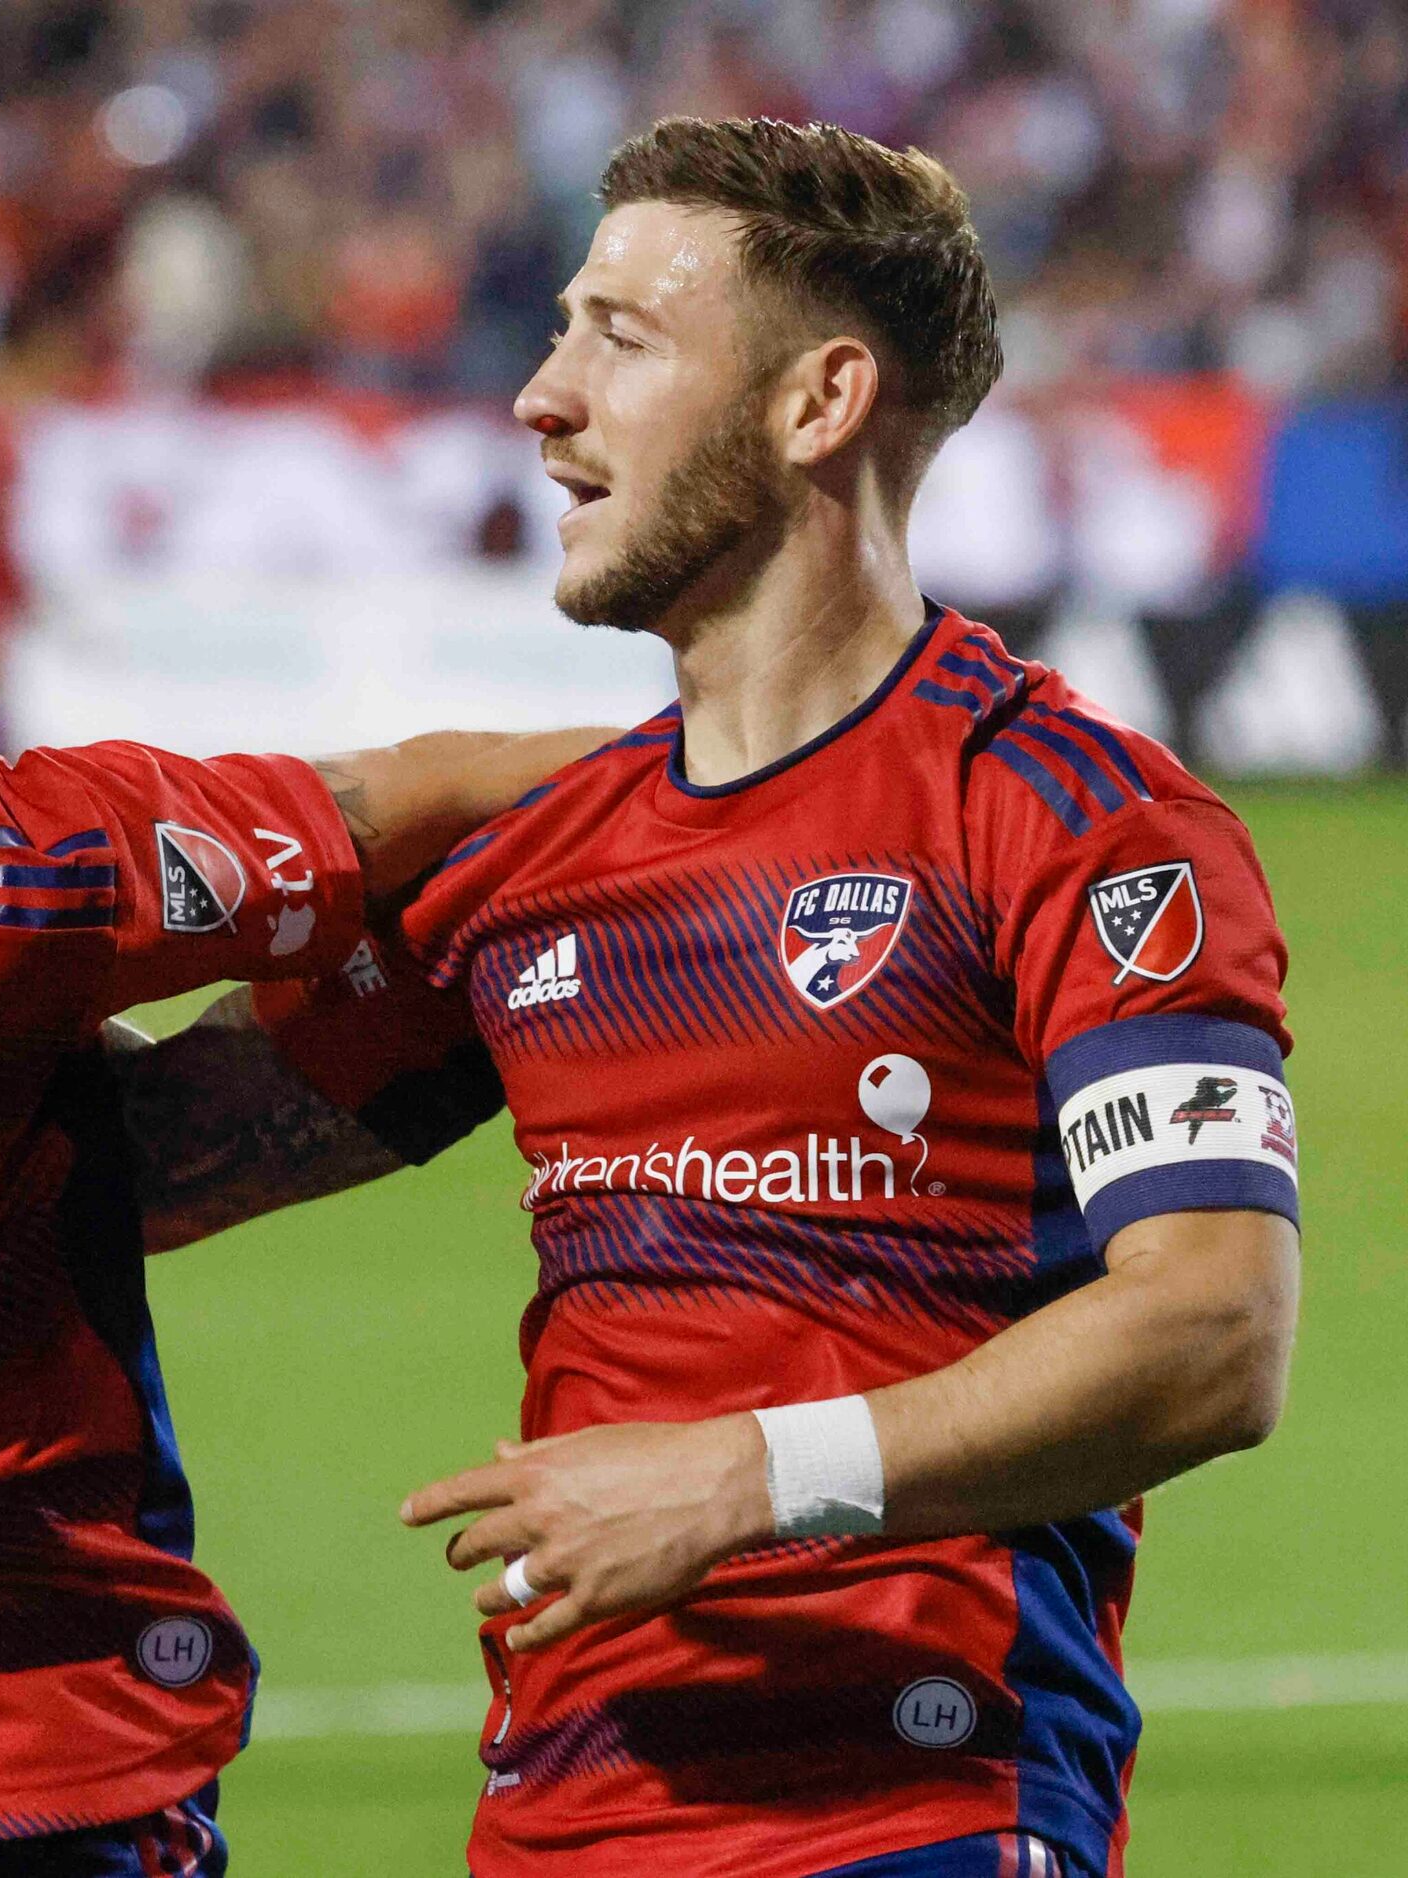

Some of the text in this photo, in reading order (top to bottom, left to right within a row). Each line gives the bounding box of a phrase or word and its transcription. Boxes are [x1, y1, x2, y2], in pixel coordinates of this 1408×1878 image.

[168, 866, 186, 922] MLS
[793, 882, 899, 920] FC DALLAS
[1098, 878, 1158, 914] MLS
[507, 977, 581, 1010] adidas
[155, 1635, 194, 1663] LH
[913, 1701, 957, 1731] LH
